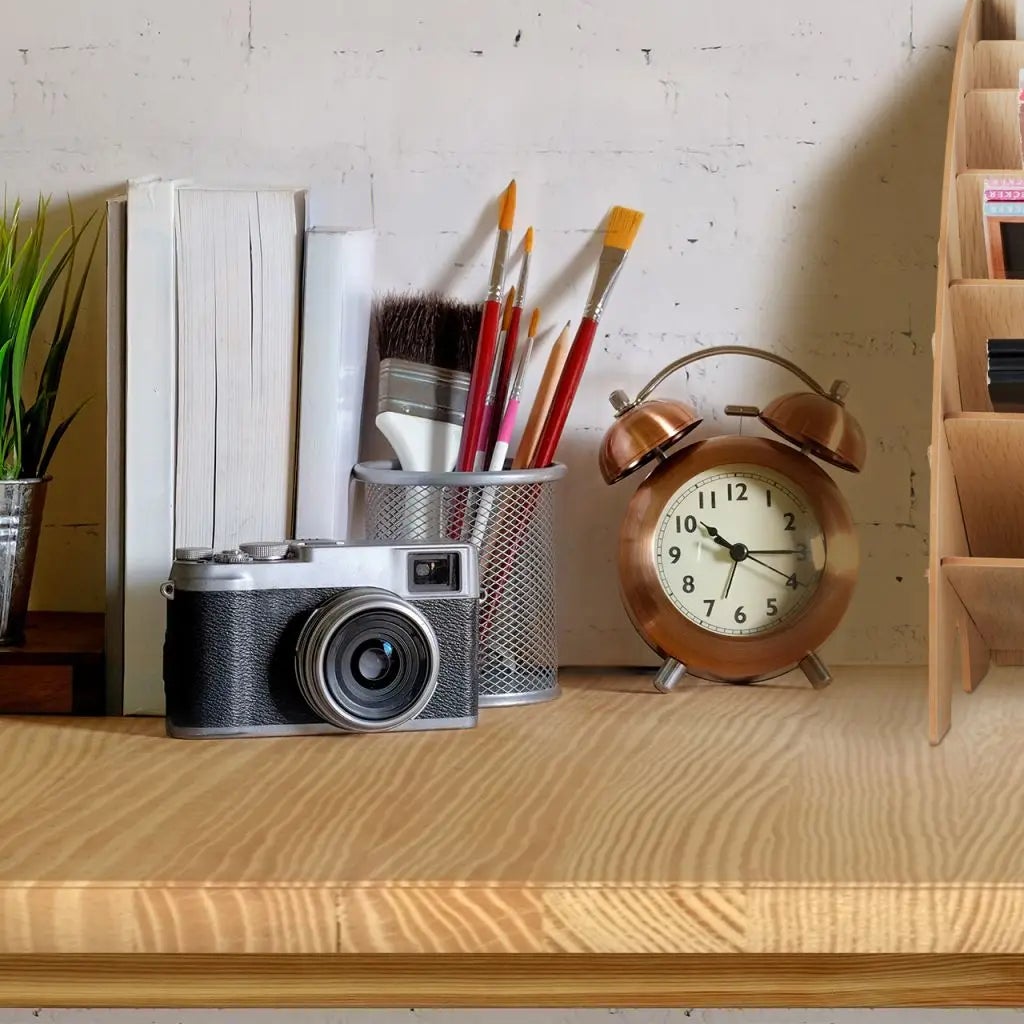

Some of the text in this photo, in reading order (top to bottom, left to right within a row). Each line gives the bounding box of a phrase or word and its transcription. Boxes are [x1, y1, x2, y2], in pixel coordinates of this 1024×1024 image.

[699, 491, 716, 509] 11
[728, 483, 748, 501] 12
[766, 489, 772, 507] 1
[676, 515, 697, 533] 10
[783, 512, 796, 531] 2
[668, 546, 681, 564] 9
[796, 543, 806, 561] 3
[682, 575, 695, 593] 8
[786, 573, 799, 590] 4
[703, 599, 716, 617] 7
[734, 606, 747, 623] 6
[766, 598, 778, 616] 5
